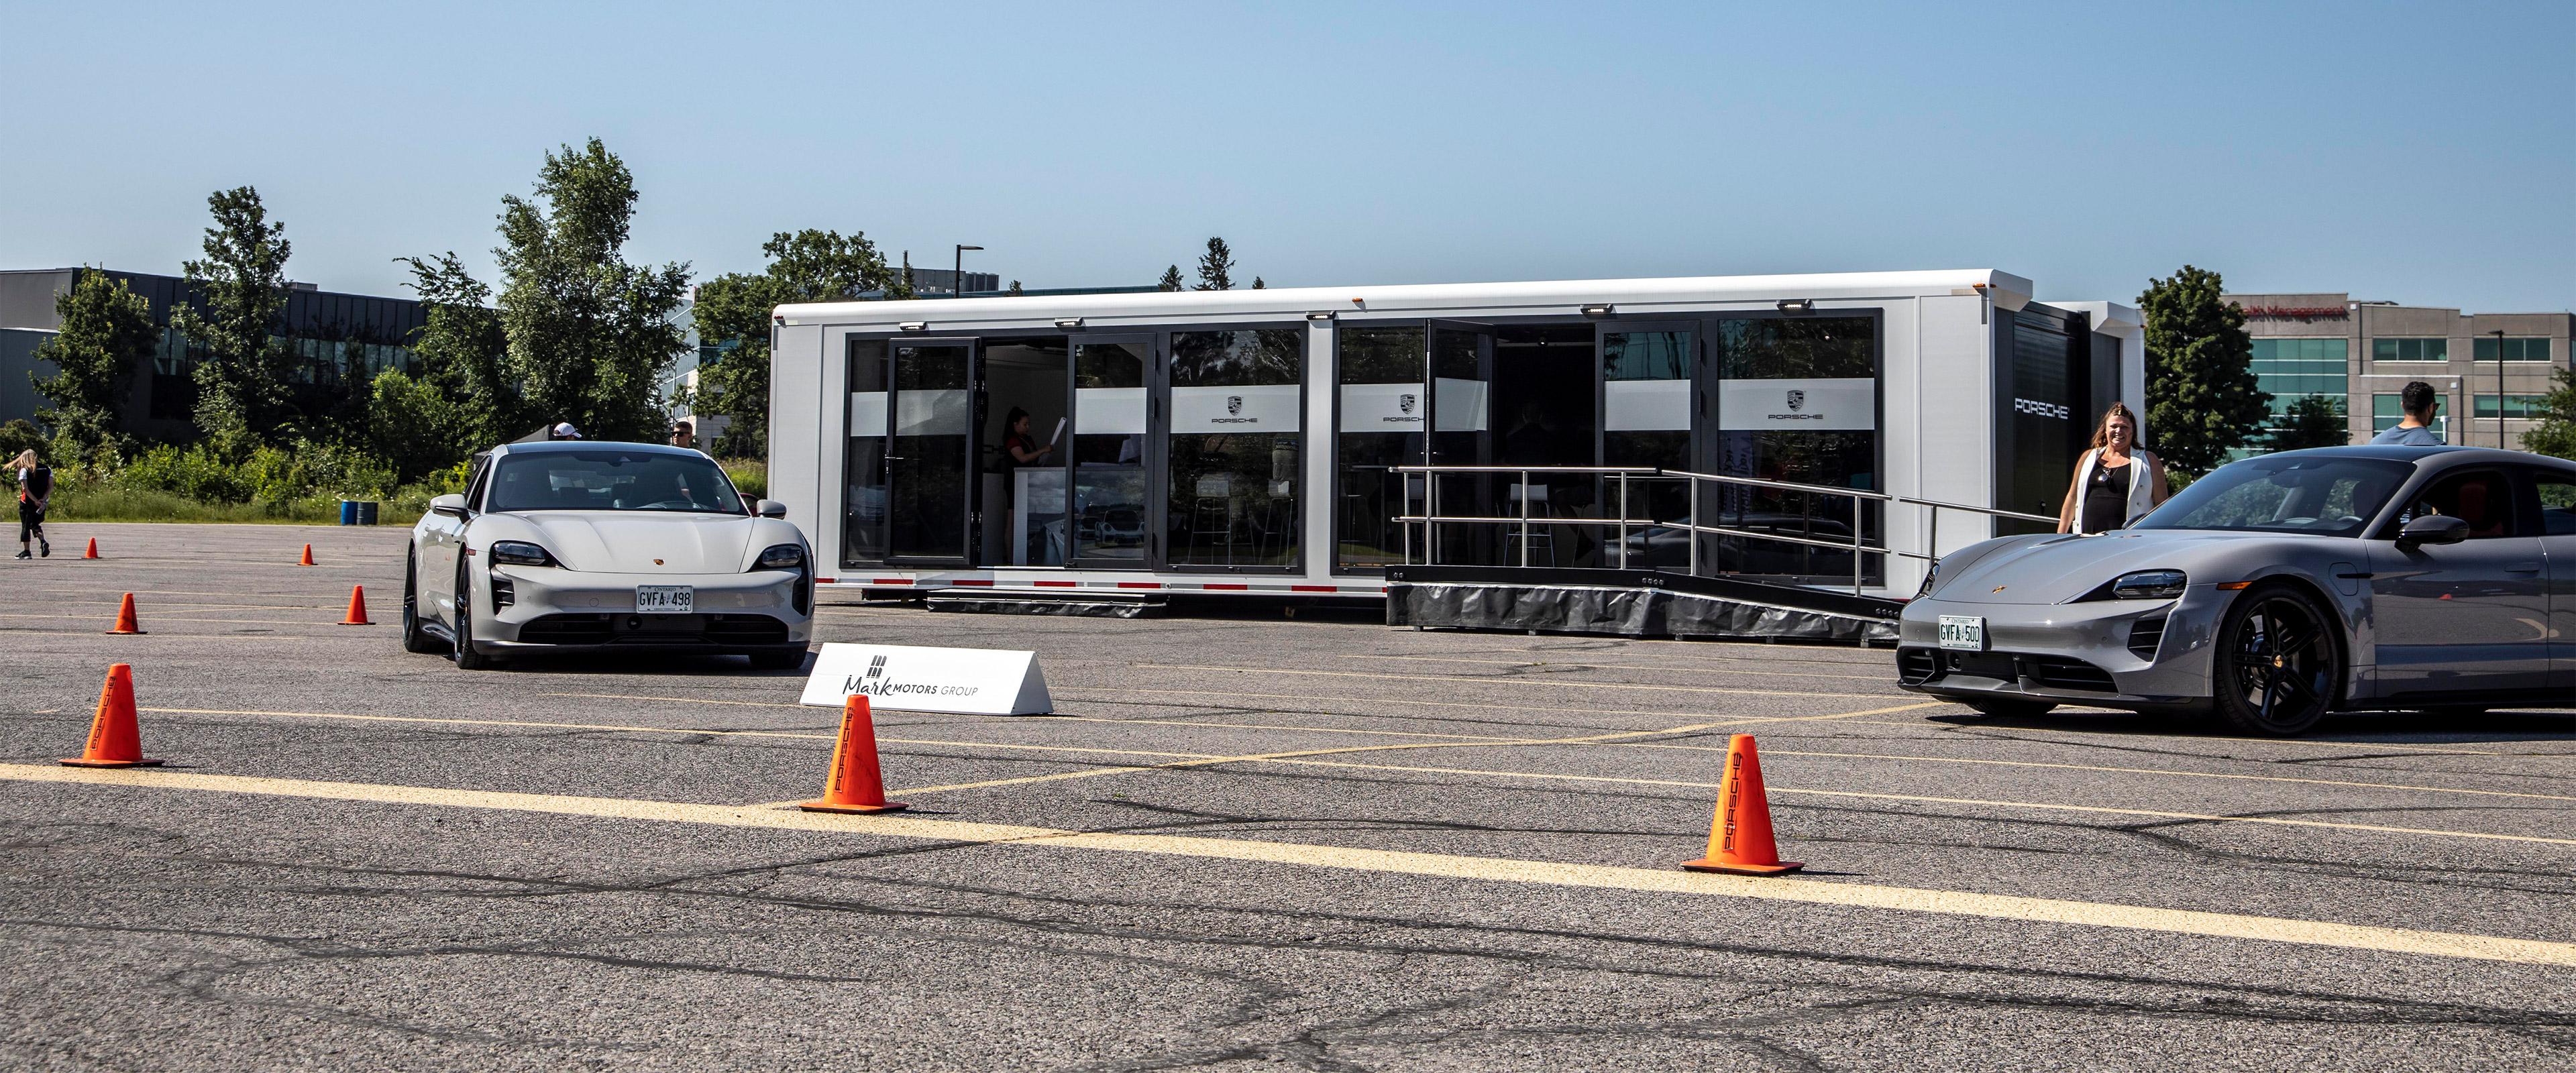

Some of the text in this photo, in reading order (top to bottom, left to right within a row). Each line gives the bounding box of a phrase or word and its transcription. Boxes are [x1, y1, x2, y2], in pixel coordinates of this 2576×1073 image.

[2267, 305, 2344, 319] Management
[2015, 398, 2069, 420] PORSCHE
[843, 675, 979, 696] Mark MOTORS GROUP
[91, 676, 117, 749] PORSCHE
[835, 707, 854, 791] PORSCHE
[1724, 752, 1743, 850] PORSCHE
